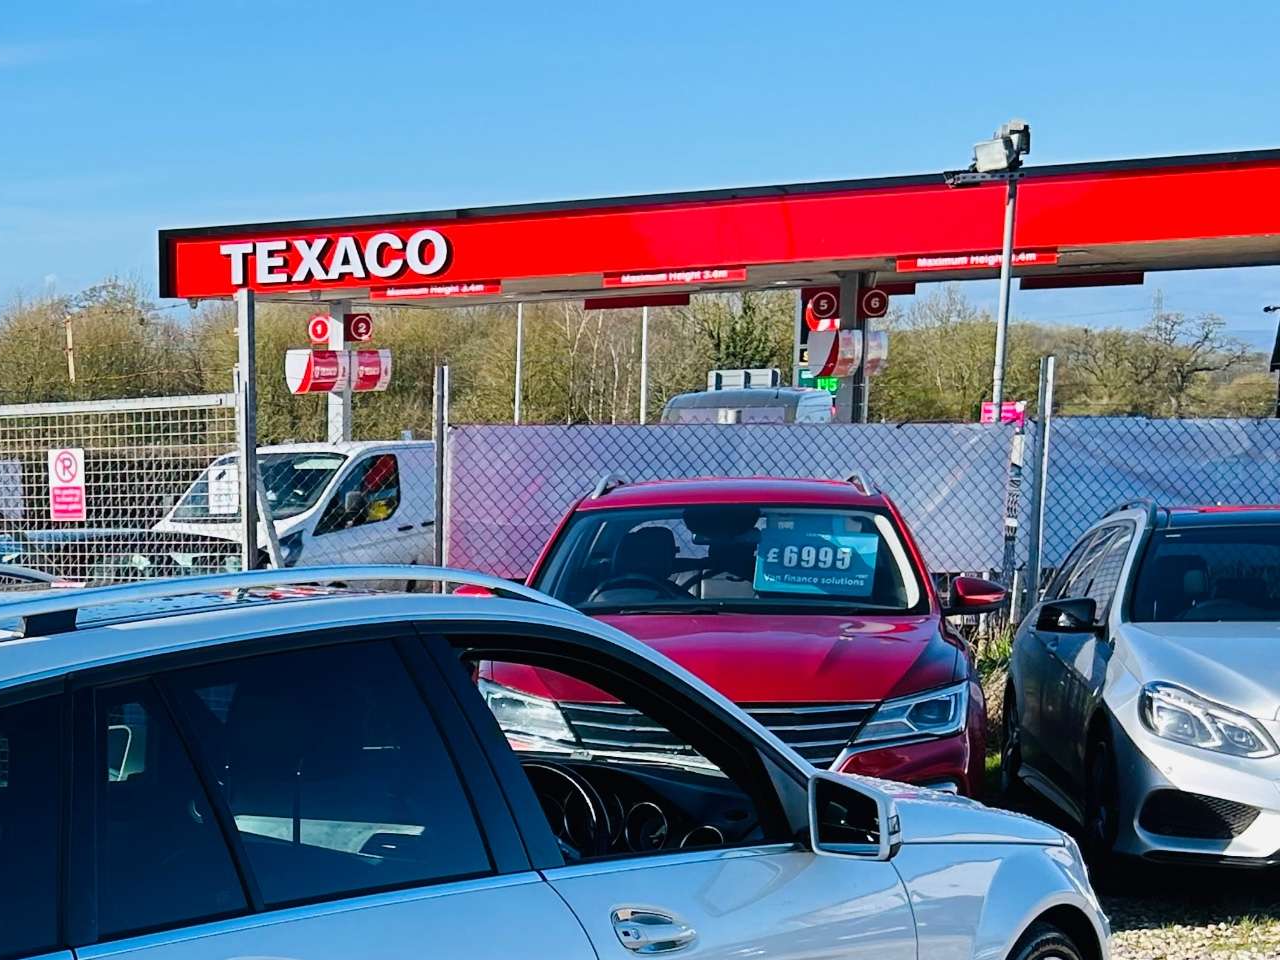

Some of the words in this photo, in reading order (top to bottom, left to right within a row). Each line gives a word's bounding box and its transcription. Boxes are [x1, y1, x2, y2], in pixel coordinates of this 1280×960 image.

[220, 229, 448, 285] TEXACO
[917, 256, 968, 268] Maximum
[970, 253, 1003, 266] Heigh
[819, 299, 829, 310] 5
[870, 297, 881, 309] 6
[357, 322, 367, 333] 2
[783, 573, 819, 584] finance
[821, 576, 865, 587] solutions
